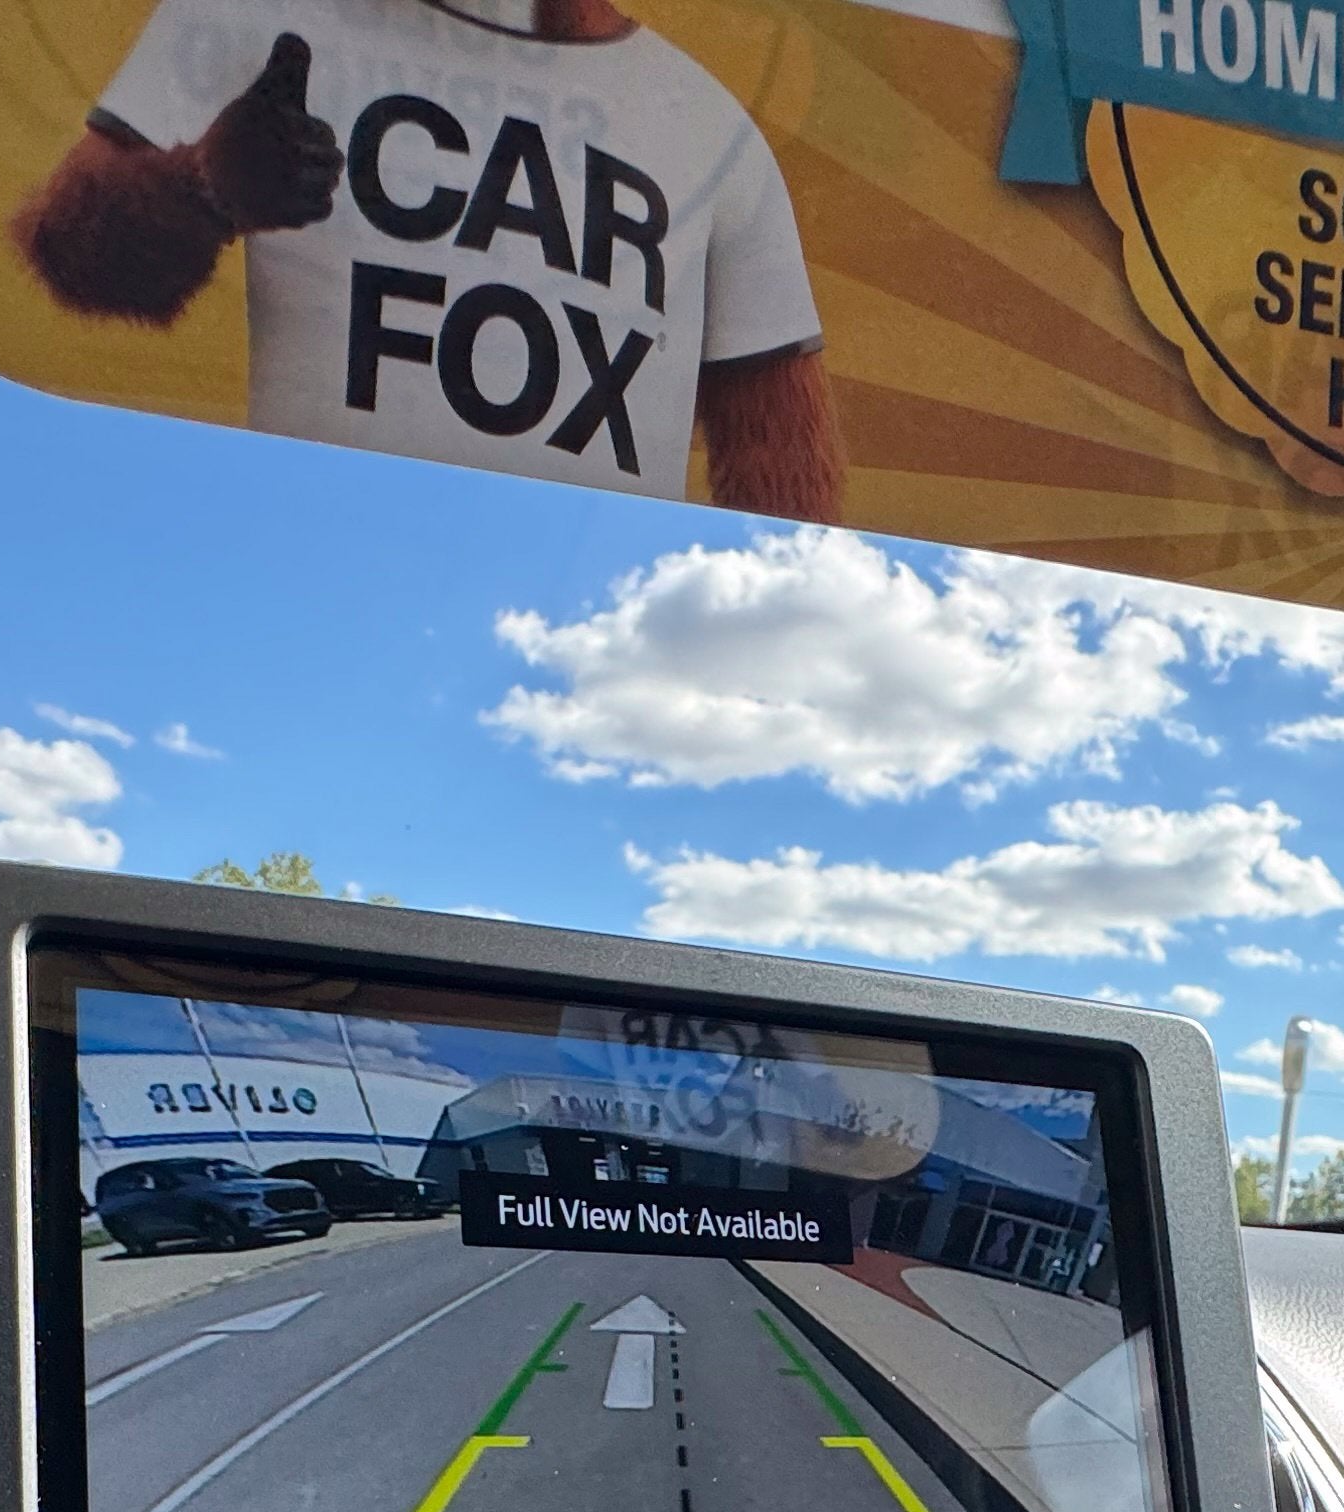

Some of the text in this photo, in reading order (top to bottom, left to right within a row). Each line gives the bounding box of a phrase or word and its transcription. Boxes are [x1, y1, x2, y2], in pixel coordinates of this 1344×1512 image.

[347, 94, 670, 316] CAR
[345, 260, 654, 477] FOX
[497, 1194, 821, 1242] Full View Not Available
